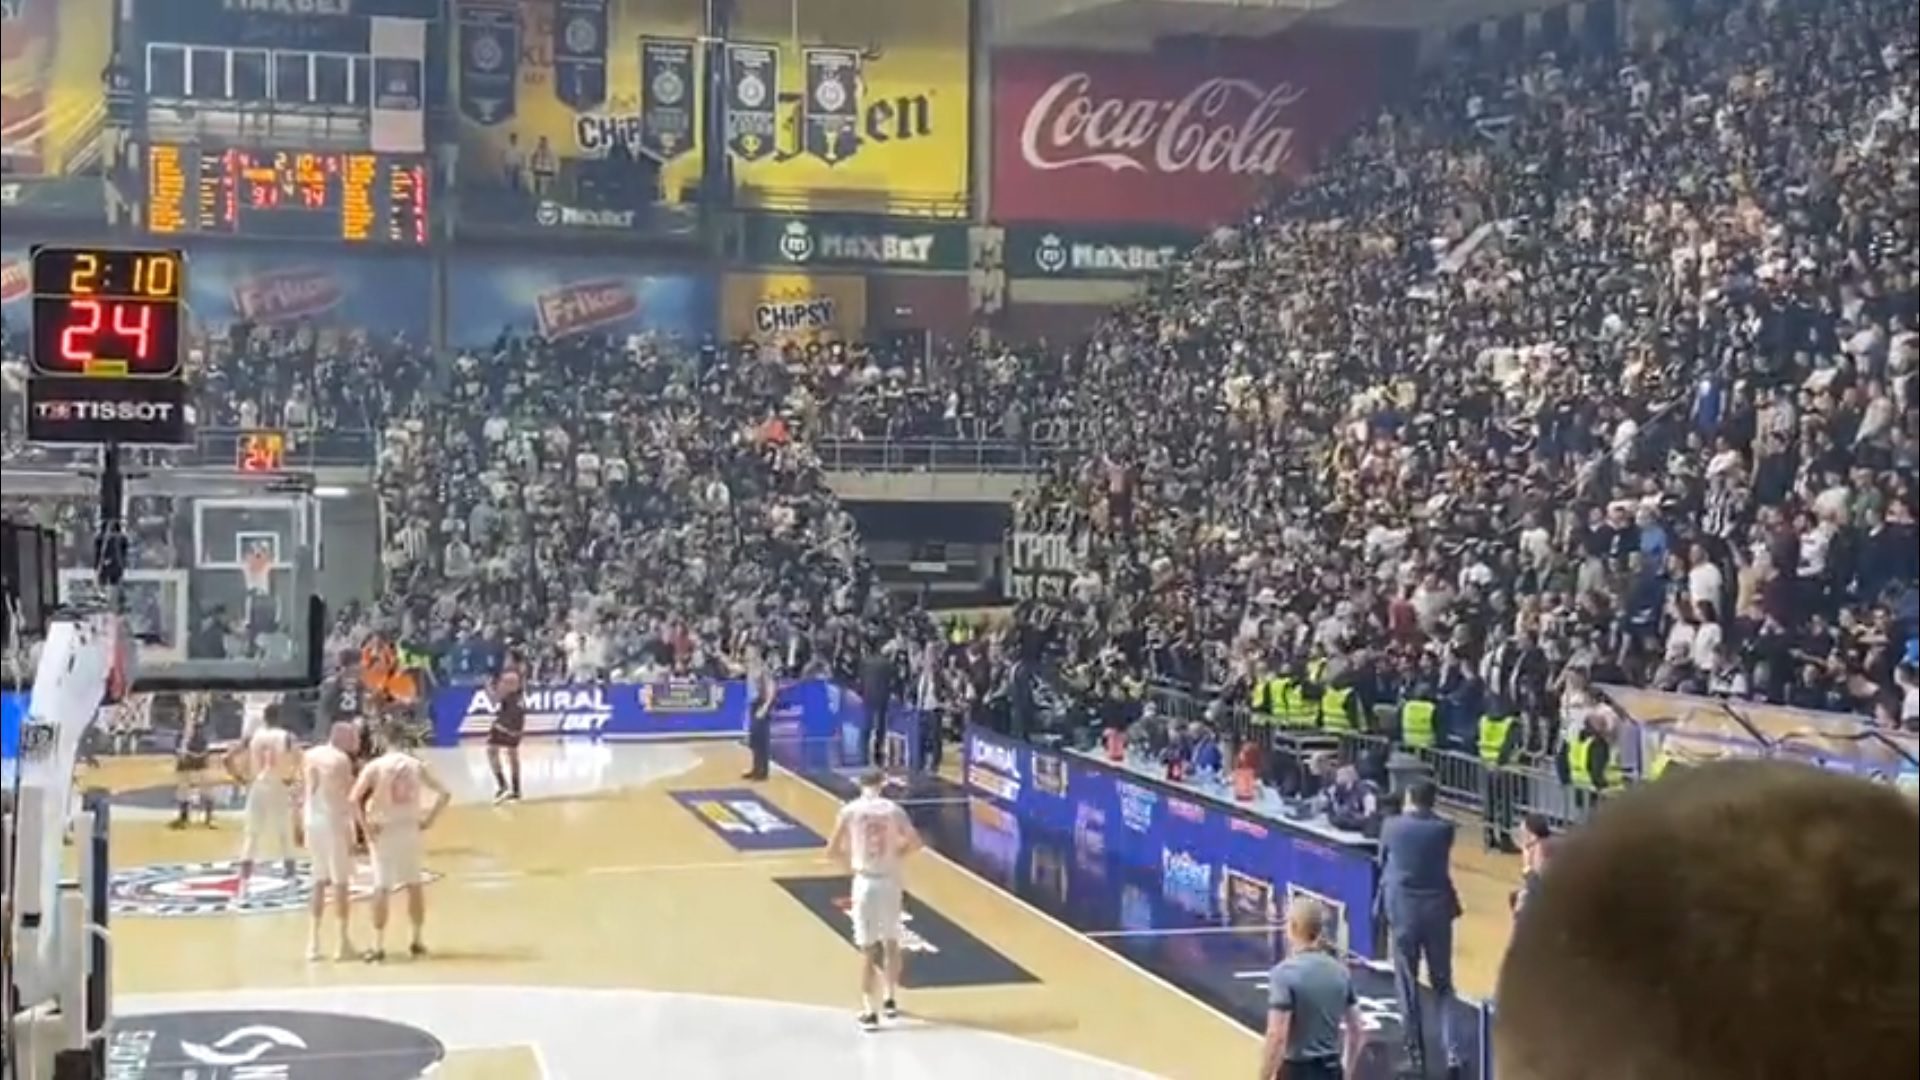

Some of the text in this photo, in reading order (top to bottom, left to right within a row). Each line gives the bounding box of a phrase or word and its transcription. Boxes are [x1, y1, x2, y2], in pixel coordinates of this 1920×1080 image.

[1020, 71, 1306, 174] Coca-Cola
[70, 253, 173, 295] 2:10
[61, 300, 151, 361] 24
[72, 401, 174, 421] TISSOT
[467, 688, 614, 713] AMIRAL
